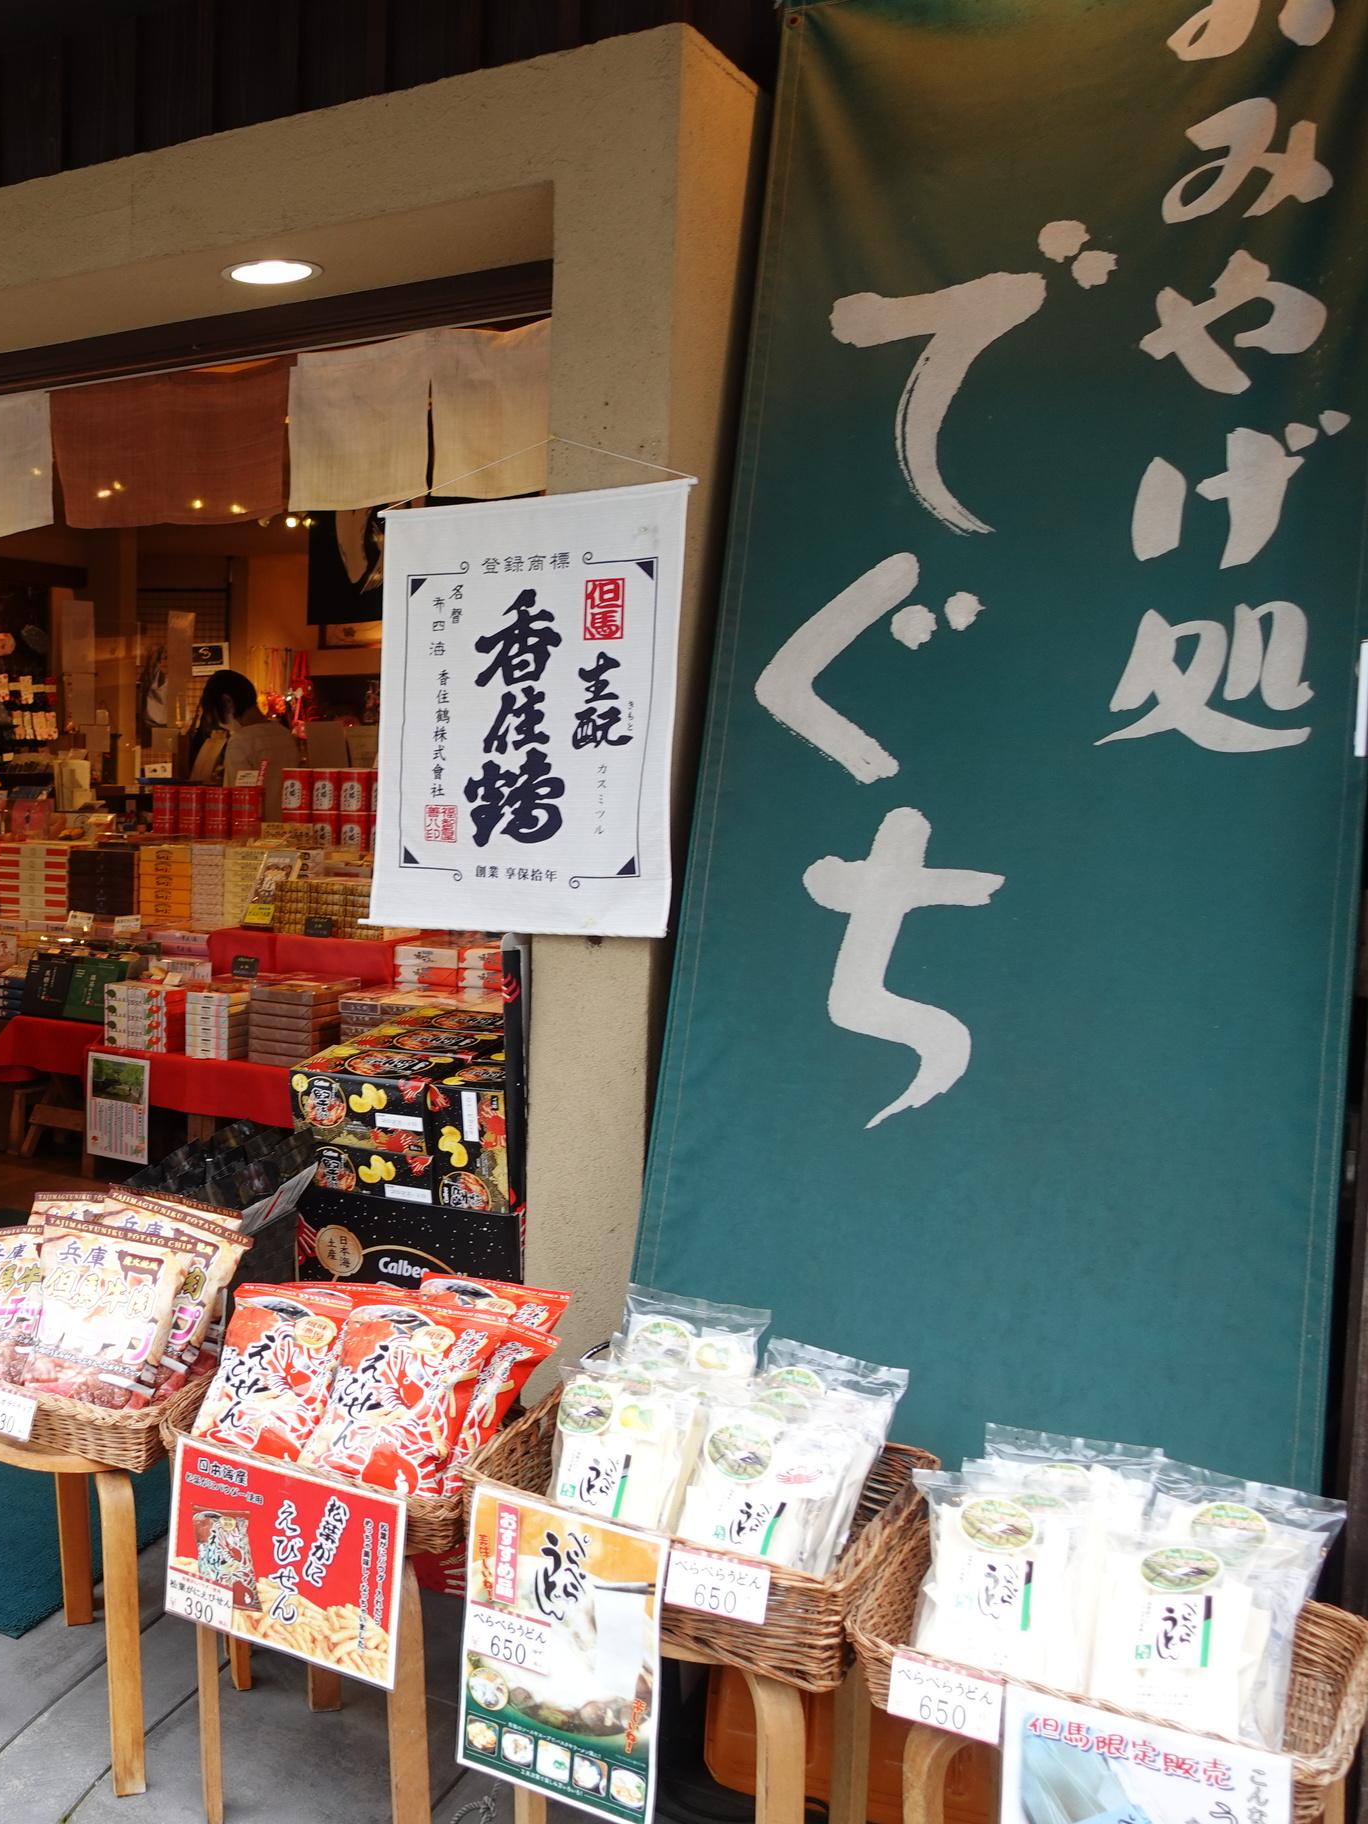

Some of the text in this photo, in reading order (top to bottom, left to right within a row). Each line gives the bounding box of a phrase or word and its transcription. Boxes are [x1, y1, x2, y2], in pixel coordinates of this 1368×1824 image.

[481, 551, 571, 575] 登録商標
[584, 578, 624, 641] 但馬
[754, 219, 1117, 1129] でぐち
[464, 588, 566, 848] 香住鶴
[593, 762, 609, 837] カスミツル
[475, 866, 558, 883] 創業 享保拾年
[127, 1230, 166, 1246] POTATO
[167, 1237, 194, 1252] CHIP
[185, 1213, 223, 1234] POTATO
[224, 1228, 249, 1245] CHIP
[59, 1240, 109, 1268] 兵庫
[219, 1334, 276, 1428] えびせん
[332, 1344, 391, 1450] えびせん
[197, 1457, 249, 1487] 日本海産
[269, 1499, 303, 1625] えびせん
[303, 1496, 350, 1588] 松葉がに
[495, 1511, 518, 1600] おすすめ品
[169, 1578, 231, 1608] 松葉がにえびせん
[535, 1531, 565, 1621] うどん
[693, 1583, 738, 1614] 650
[185, 1597, 215, 1624] 390
[490, 1634, 527, 1665] 650
[919, 1695, 966, 1730] 650
[1027, 1716, 1235, 1791] 但馬限定販売
